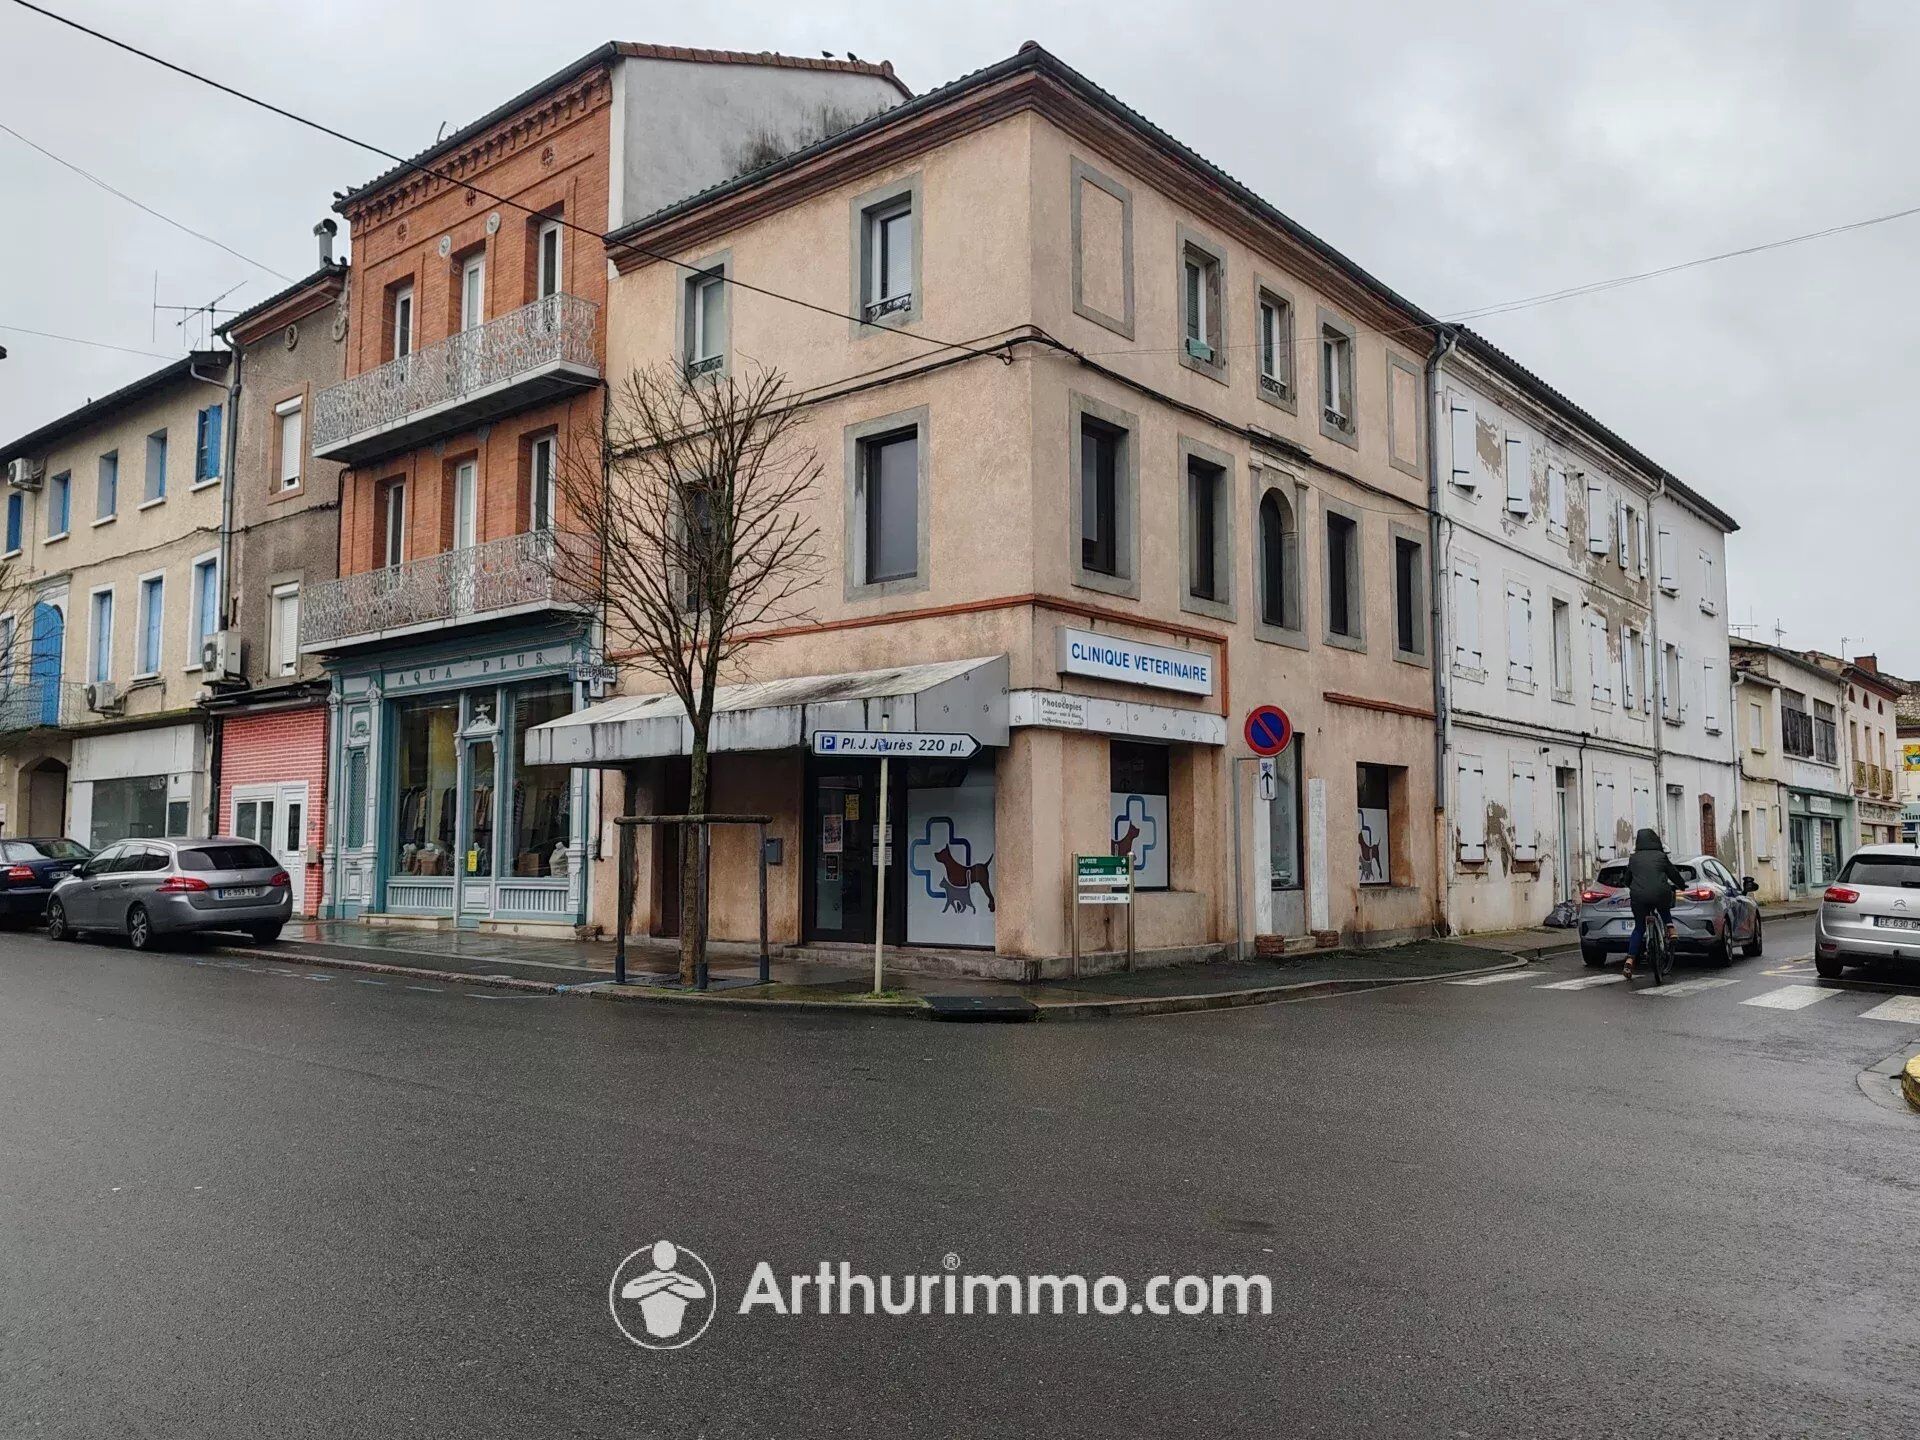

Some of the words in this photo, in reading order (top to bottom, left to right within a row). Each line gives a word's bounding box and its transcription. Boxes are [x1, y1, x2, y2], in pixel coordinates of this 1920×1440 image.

[398, 666, 453, 686] AQUA
[483, 651, 544, 673] PLUS
[1071, 643, 1130, 668] CLINIQUE
[1134, 655, 1207, 682] VETERINAIRE
[1041, 697, 1082, 712] Photocopies
[918, 739, 945, 751] 220
[950, 742, 965, 754] pl.
